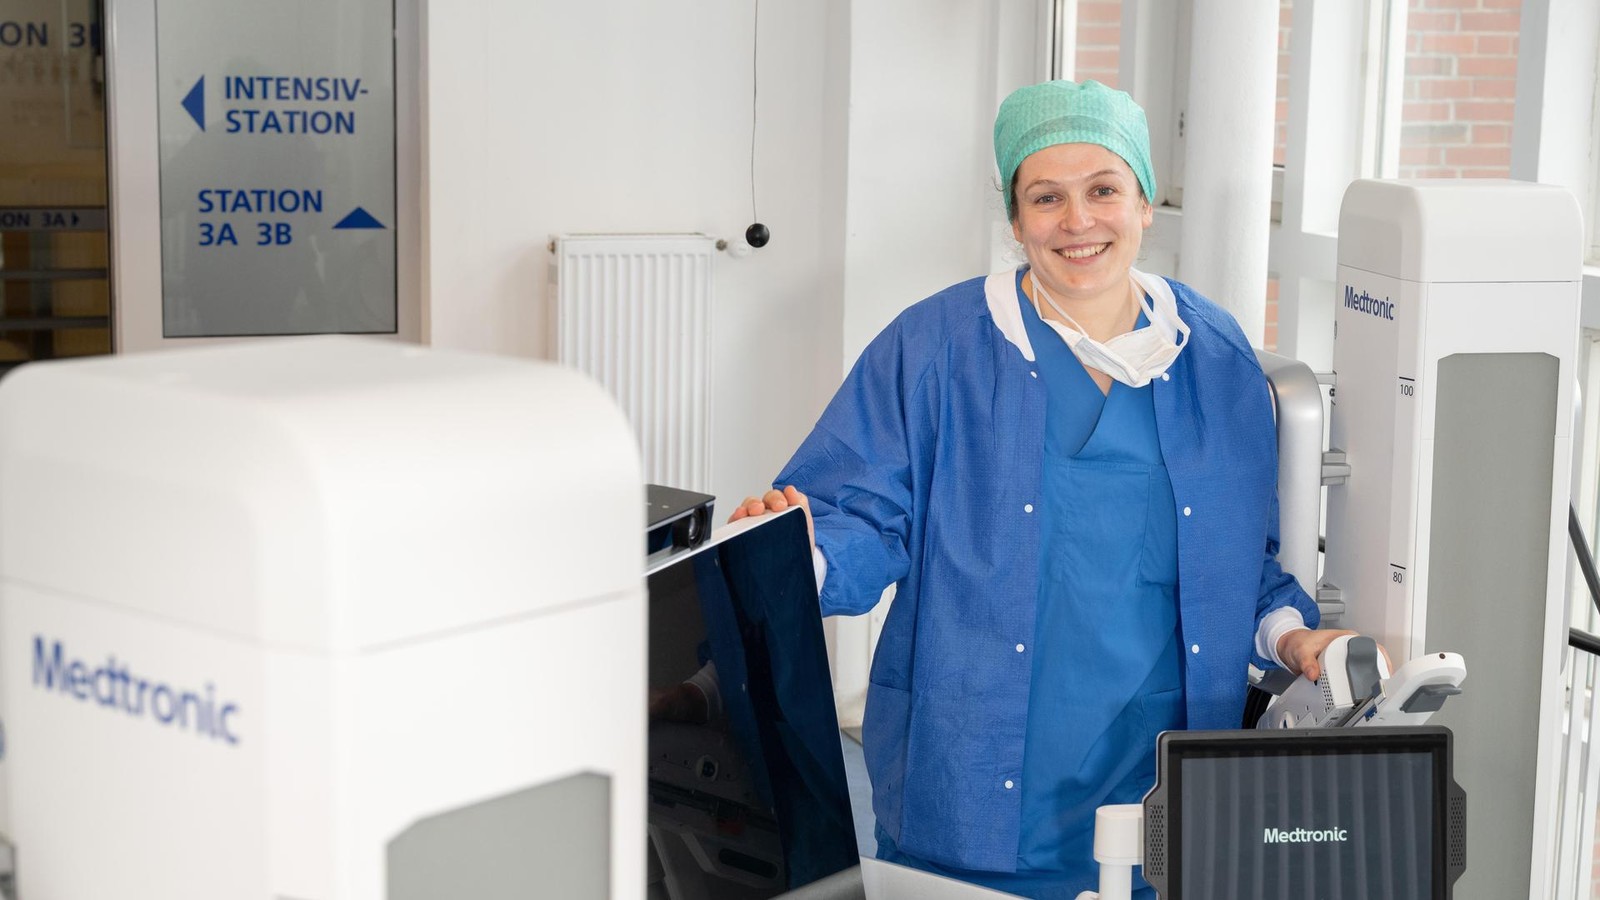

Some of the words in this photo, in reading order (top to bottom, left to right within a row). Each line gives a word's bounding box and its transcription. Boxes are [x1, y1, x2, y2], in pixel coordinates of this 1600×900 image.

[224, 75, 369, 101] INTENSIV-
[225, 109, 355, 134] STATION
[198, 189, 323, 213] STATION
[198, 222, 238, 246] 3A
[256, 222, 292, 246] 3B
[1344, 284, 1395, 321] Medtronic
[1400, 383, 1414, 397] 100
[1392, 571, 1403, 584] 80
[33, 634, 241, 746] Medtronic
[1263, 826, 1348, 843] Medtronic
